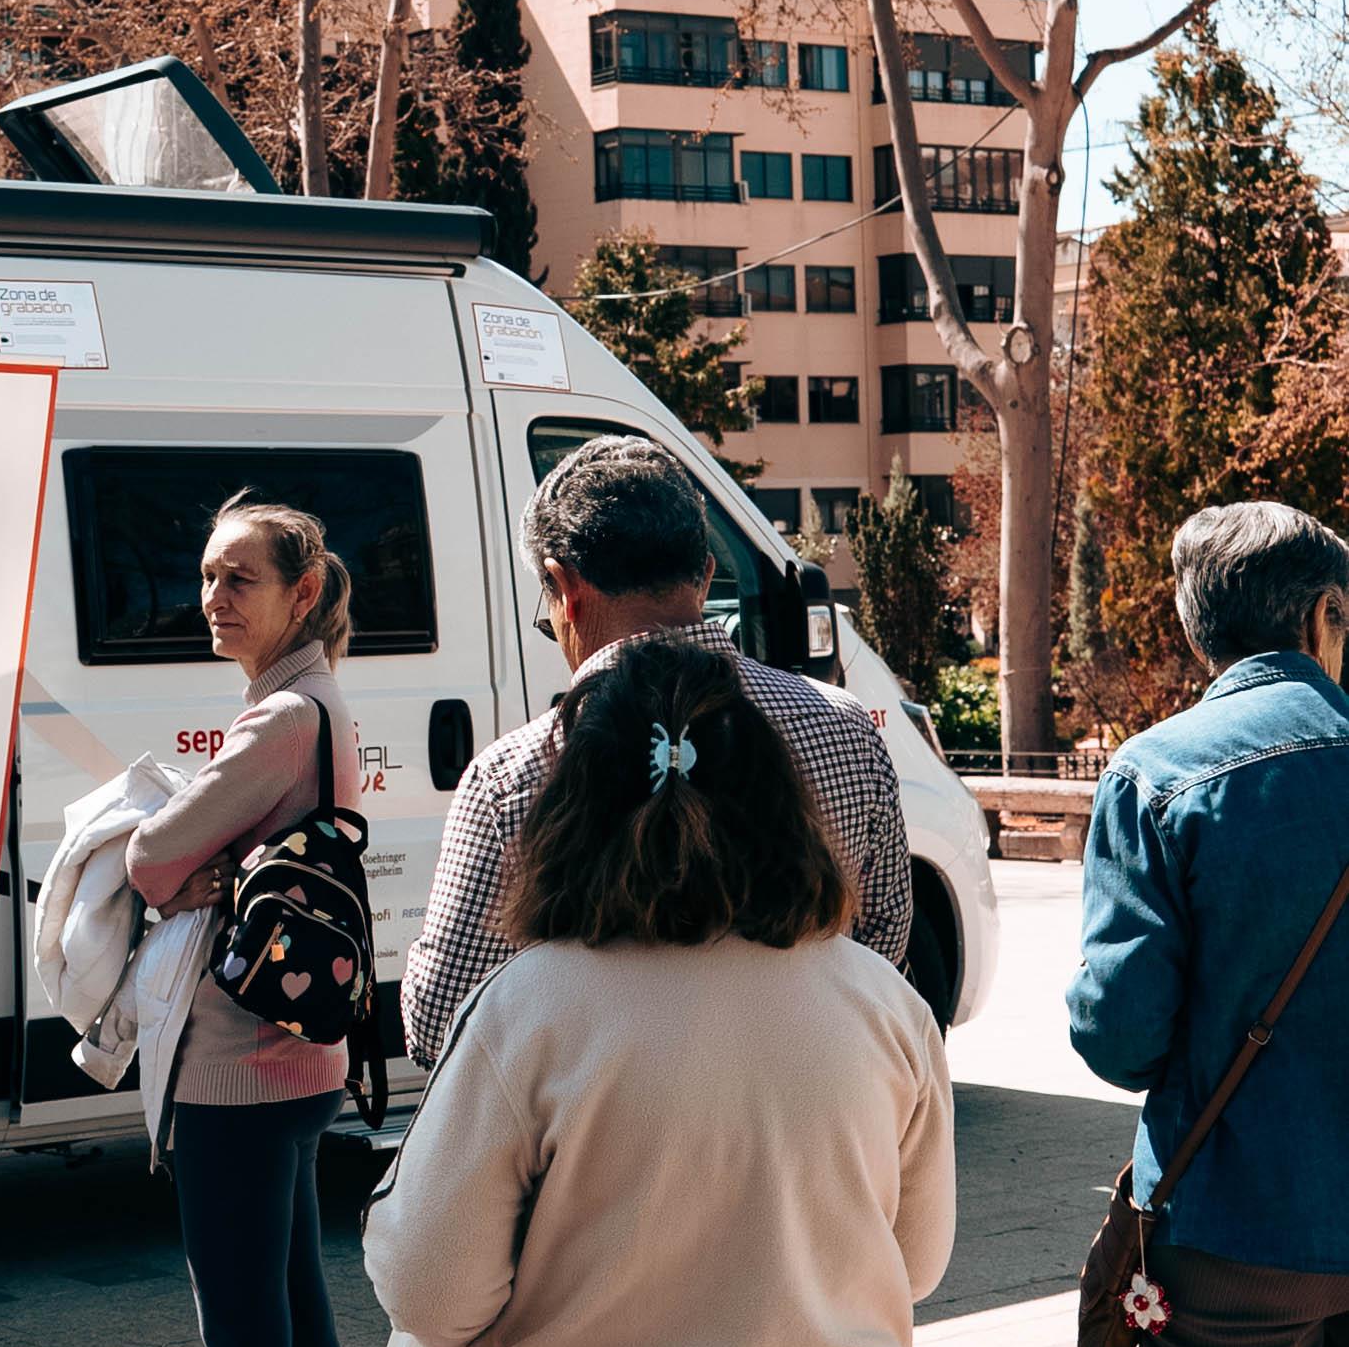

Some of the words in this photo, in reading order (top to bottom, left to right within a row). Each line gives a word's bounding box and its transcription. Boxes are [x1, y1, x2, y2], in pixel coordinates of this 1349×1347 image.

[39, 289, 57, 301] de
[0, 300, 73, 316] grabación
[482, 311, 514, 325] Zona
[515, 315, 531, 327] de
[177, 729, 225, 760] sep
[362, 852, 406, 865] Boehringer
[366, 865, 403, 880] ngelheim
[371, 908, 391, 922] nofi
